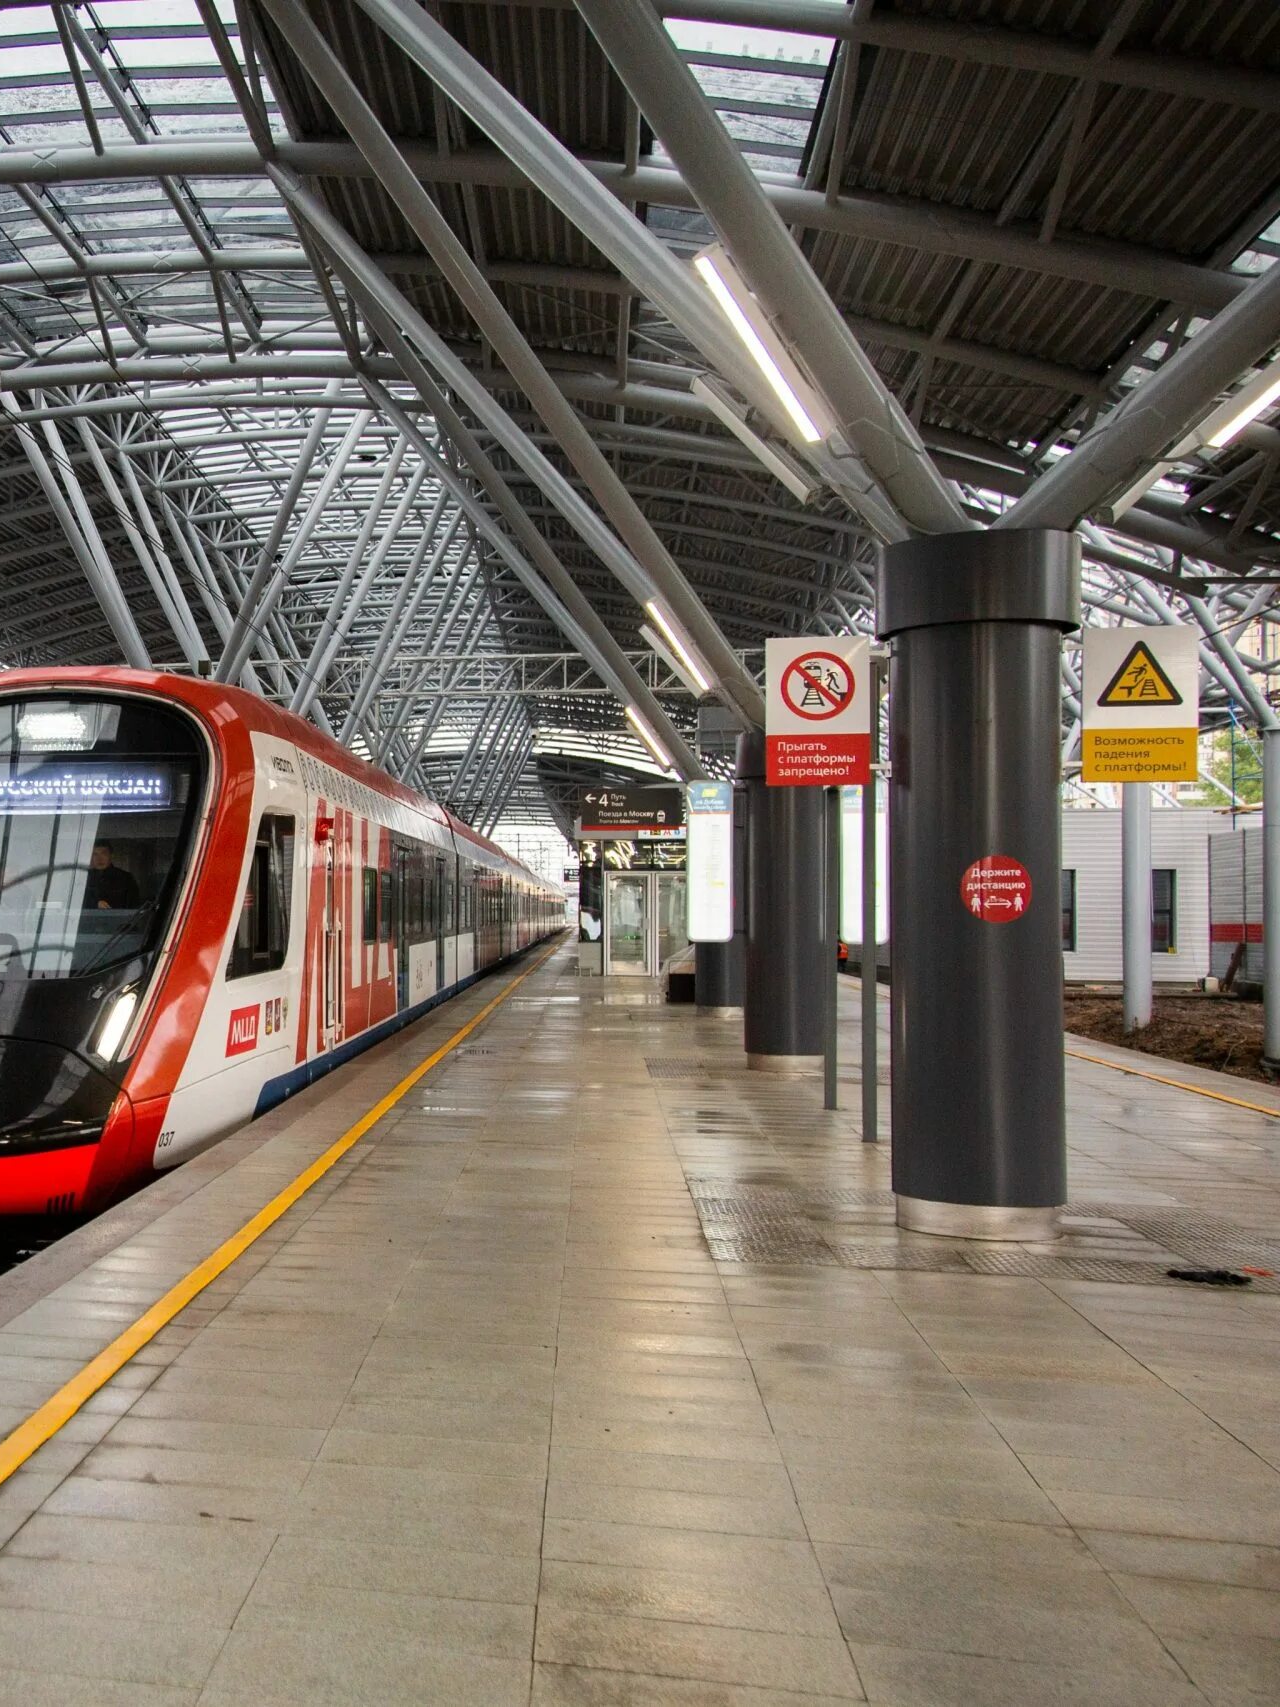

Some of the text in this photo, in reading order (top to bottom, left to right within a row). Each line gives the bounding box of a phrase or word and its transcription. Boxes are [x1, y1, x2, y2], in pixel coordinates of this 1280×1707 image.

[1094, 736, 1185, 746] Возможность
[777, 742, 827, 754] Прыгать
[778, 753, 856, 766] с платформы
[1094, 750, 1150, 760] падения
[778, 765, 849, 779] запрещено!
[1094, 761, 1187, 773] с платформы!
[598, 793, 627, 807] 4 Путь
[598, 810, 623, 819] Поезда
[971, 868, 1022, 878] Держите
[966, 882, 1026, 892] дистанцию
[230, 1015, 256, 1045] МЦД
[158, 1130, 175, 1148] 037
